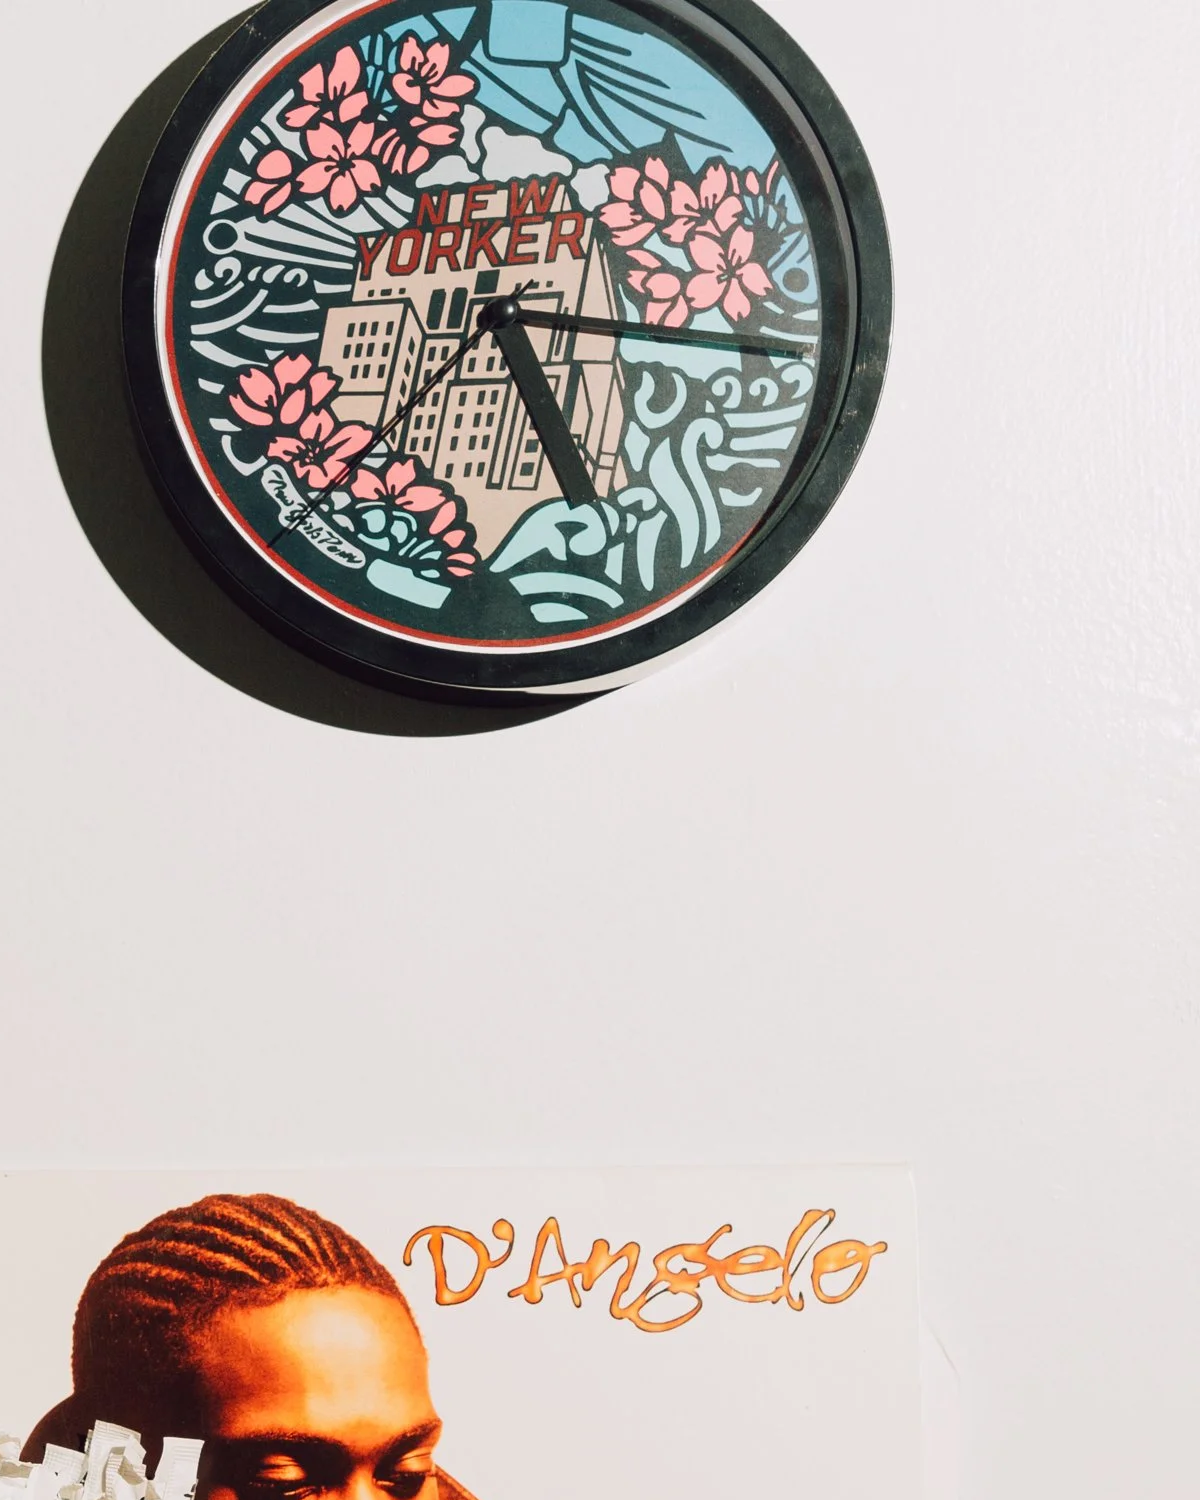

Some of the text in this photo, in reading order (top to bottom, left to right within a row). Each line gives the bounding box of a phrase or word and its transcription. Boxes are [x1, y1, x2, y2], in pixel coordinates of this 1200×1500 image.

[416, 175, 560, 228] NEW
[357, 212, 586, 280] YORKER
[401, 1207, 889, 1334] D'Angelo
